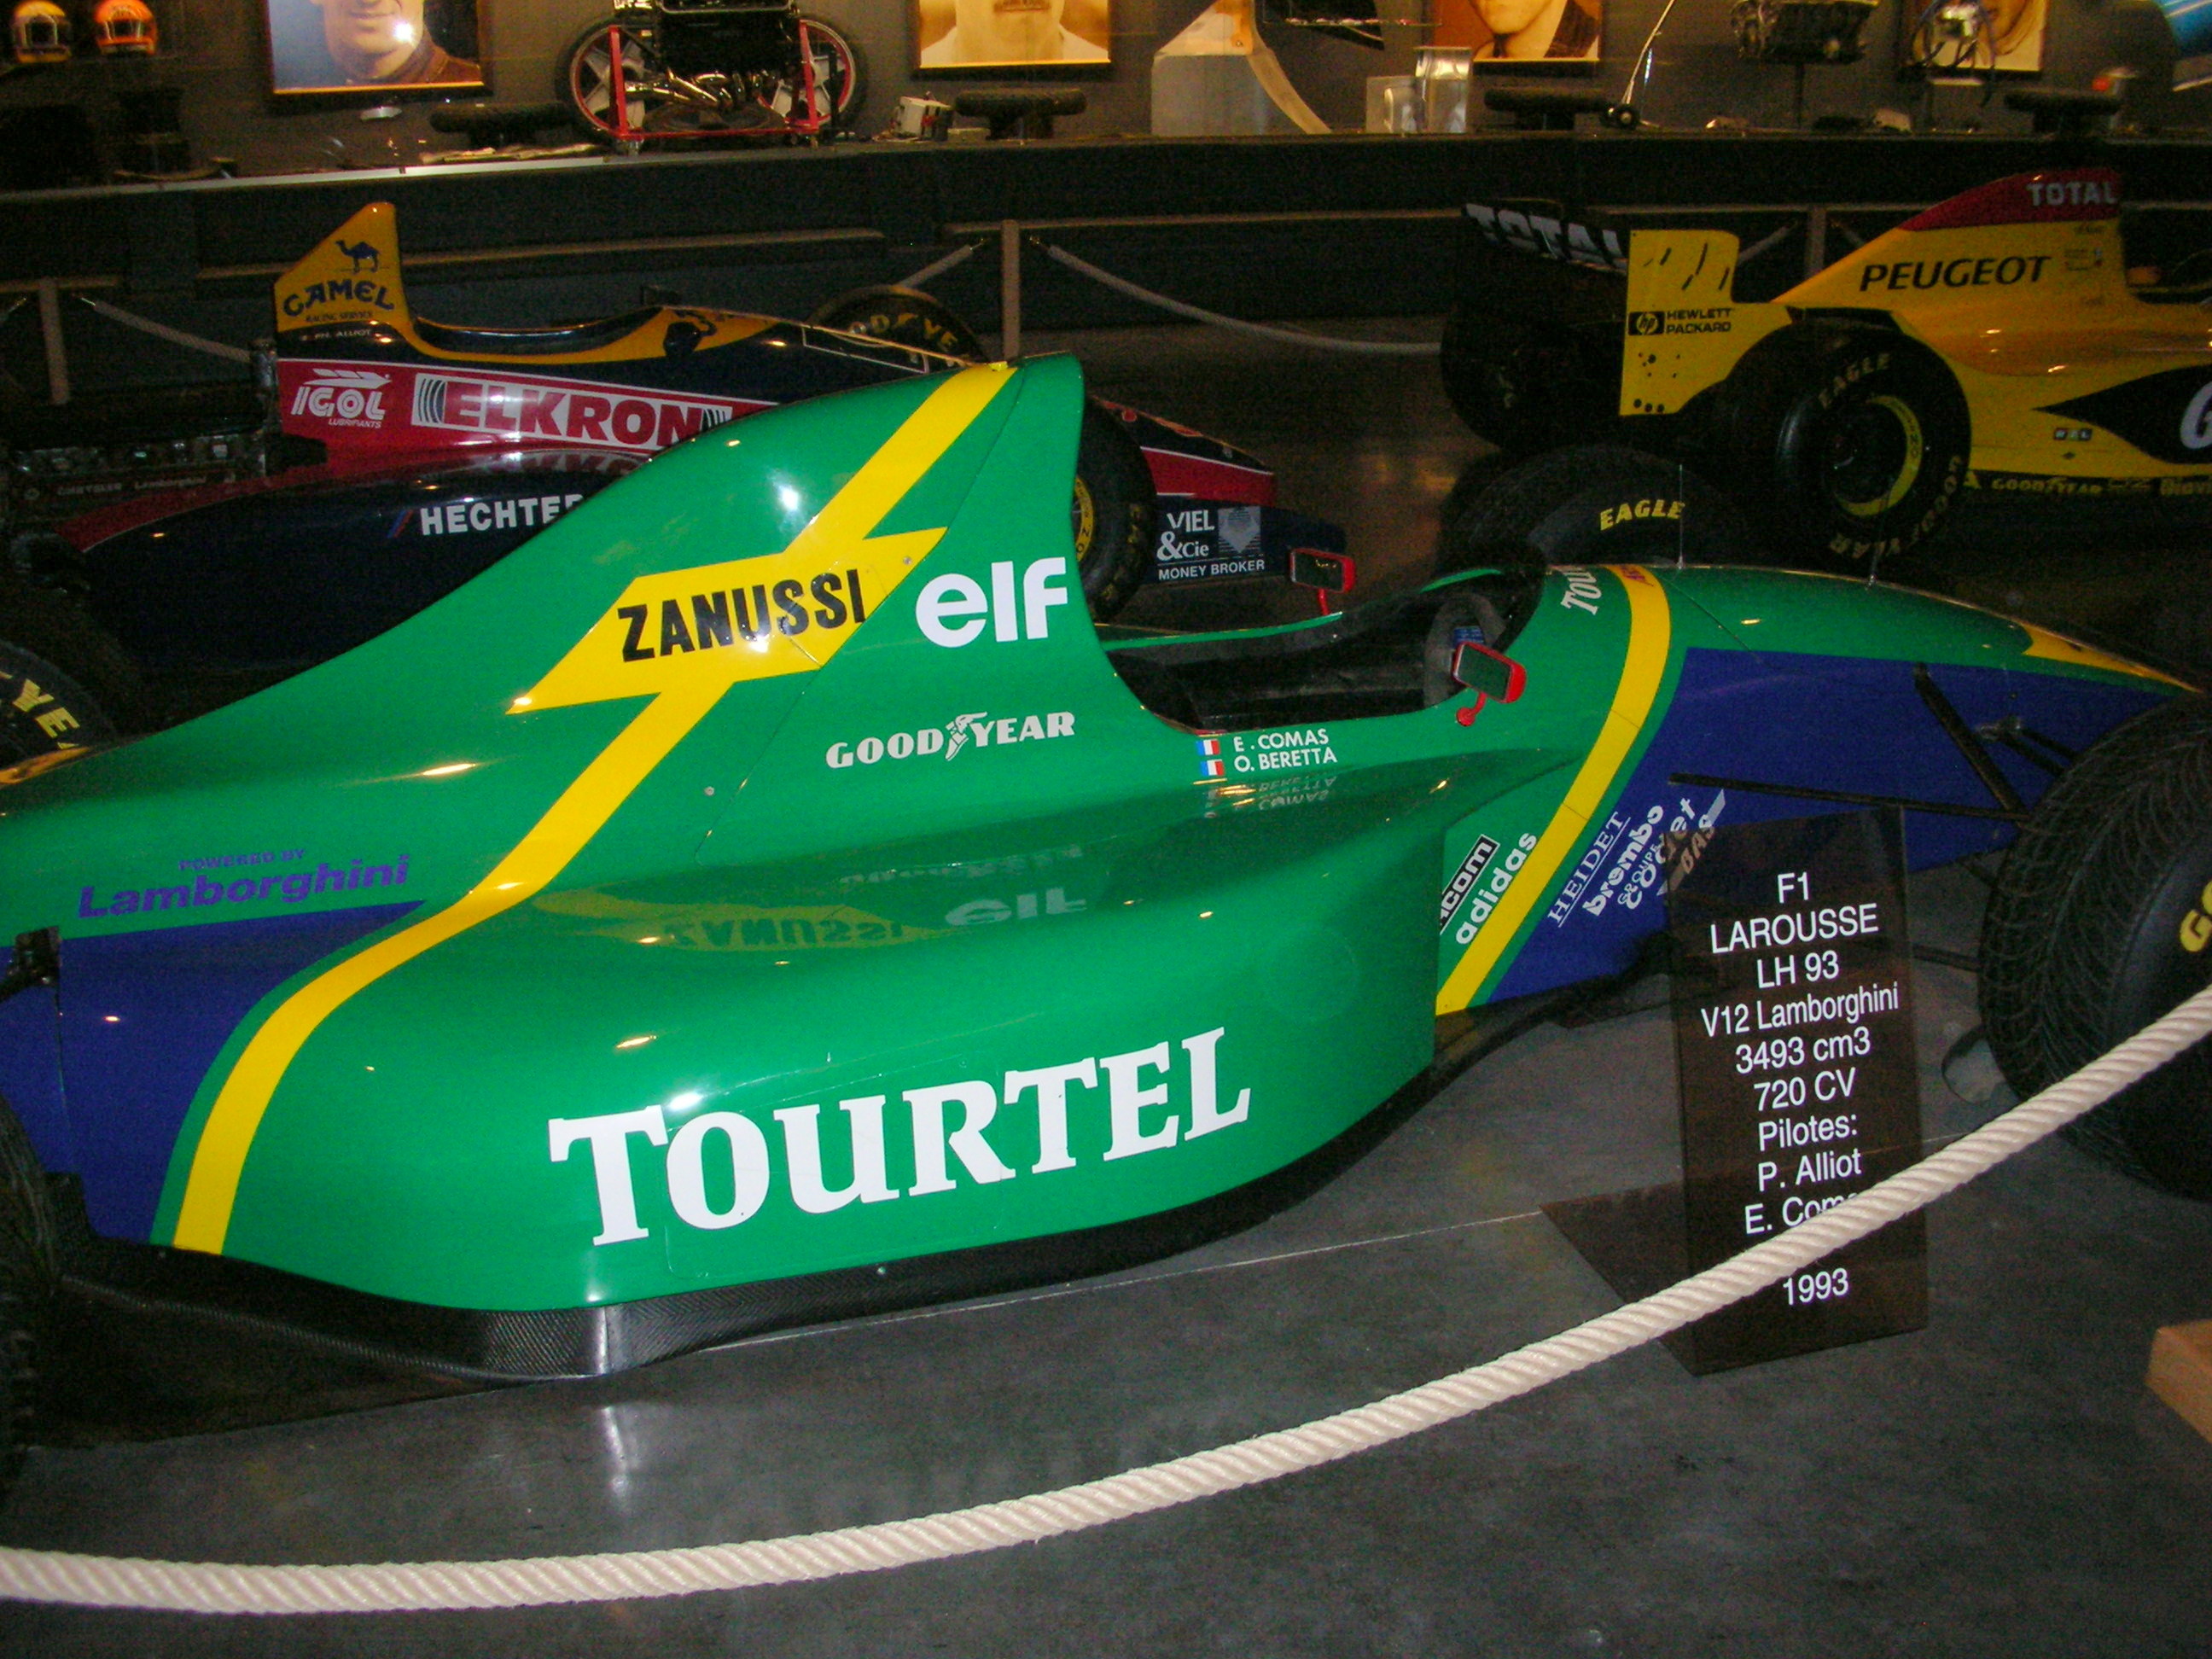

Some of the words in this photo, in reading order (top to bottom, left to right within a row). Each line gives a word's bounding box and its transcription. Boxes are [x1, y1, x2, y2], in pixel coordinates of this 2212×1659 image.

[2027, 181, 2118, 207] TOTAL
[1860, 257, 2051, 291] PEUGEOT
[283, 279, 394, 317] CAMEL
[1667, 308, 1732, 319] HEWLETT
[1667, 322, 1731, 334] PACKARD
[290, 386, 387, 421] IGOL
[444, 381, 705, 447] ELKRON
[1166, 509, 1215, 533] VIEL
[1599, 498, 1686, 532] EAGLE
[1158, 564, 1208, 580] MONEY
[1210, 559, 1266, 575] BROKER
[617, 568, 867, 662] ZANUSSI
[915, 556, 1068, 649] elf
[1258, 729, 1330, 750] COMAS
[1234, 755, 1255, 772] O.
[1258, 747, 1338, 771] BERETTA
[178, 852, 275, 871] POWERED
[281, 848, 306, 861] BY
[1547, 812, 1624, 923] HEIDET
[1582, 805, 1663, 917] brembo
[79, 854, 410, 919] Lamborghini
[1455, 833, 1537, 945] adidas
[1778, 871, 1809, 904] F1
[1710, 902, 1879, 954] LAROUSSE
[1756, 954, 1796, 989] LH
[1804, 950, 1840, 982] 93
[1701, 1003, 1750, 1038] V12
[1756, 981, 1899, 1030] Lamborghini
[1736, 1036, 1805, 1074] 3493
[1813, 1026, 1871, 1062] cm3
[1753, 1076, 1806, 1111] 720
[1814, 1067, 1856, 1101] CV
[548, 1026, 1251, 1247] TOURTEL
[1758, 1114, 1857, 1152] Pilotes:
[1758, 1161, 1785, 1192] P.
[1795, 1148, 1862, 1185] Alliot
[1744, 1203, 1773, 1235] E.
[1783, 1268, 1848, 1306] 1993
